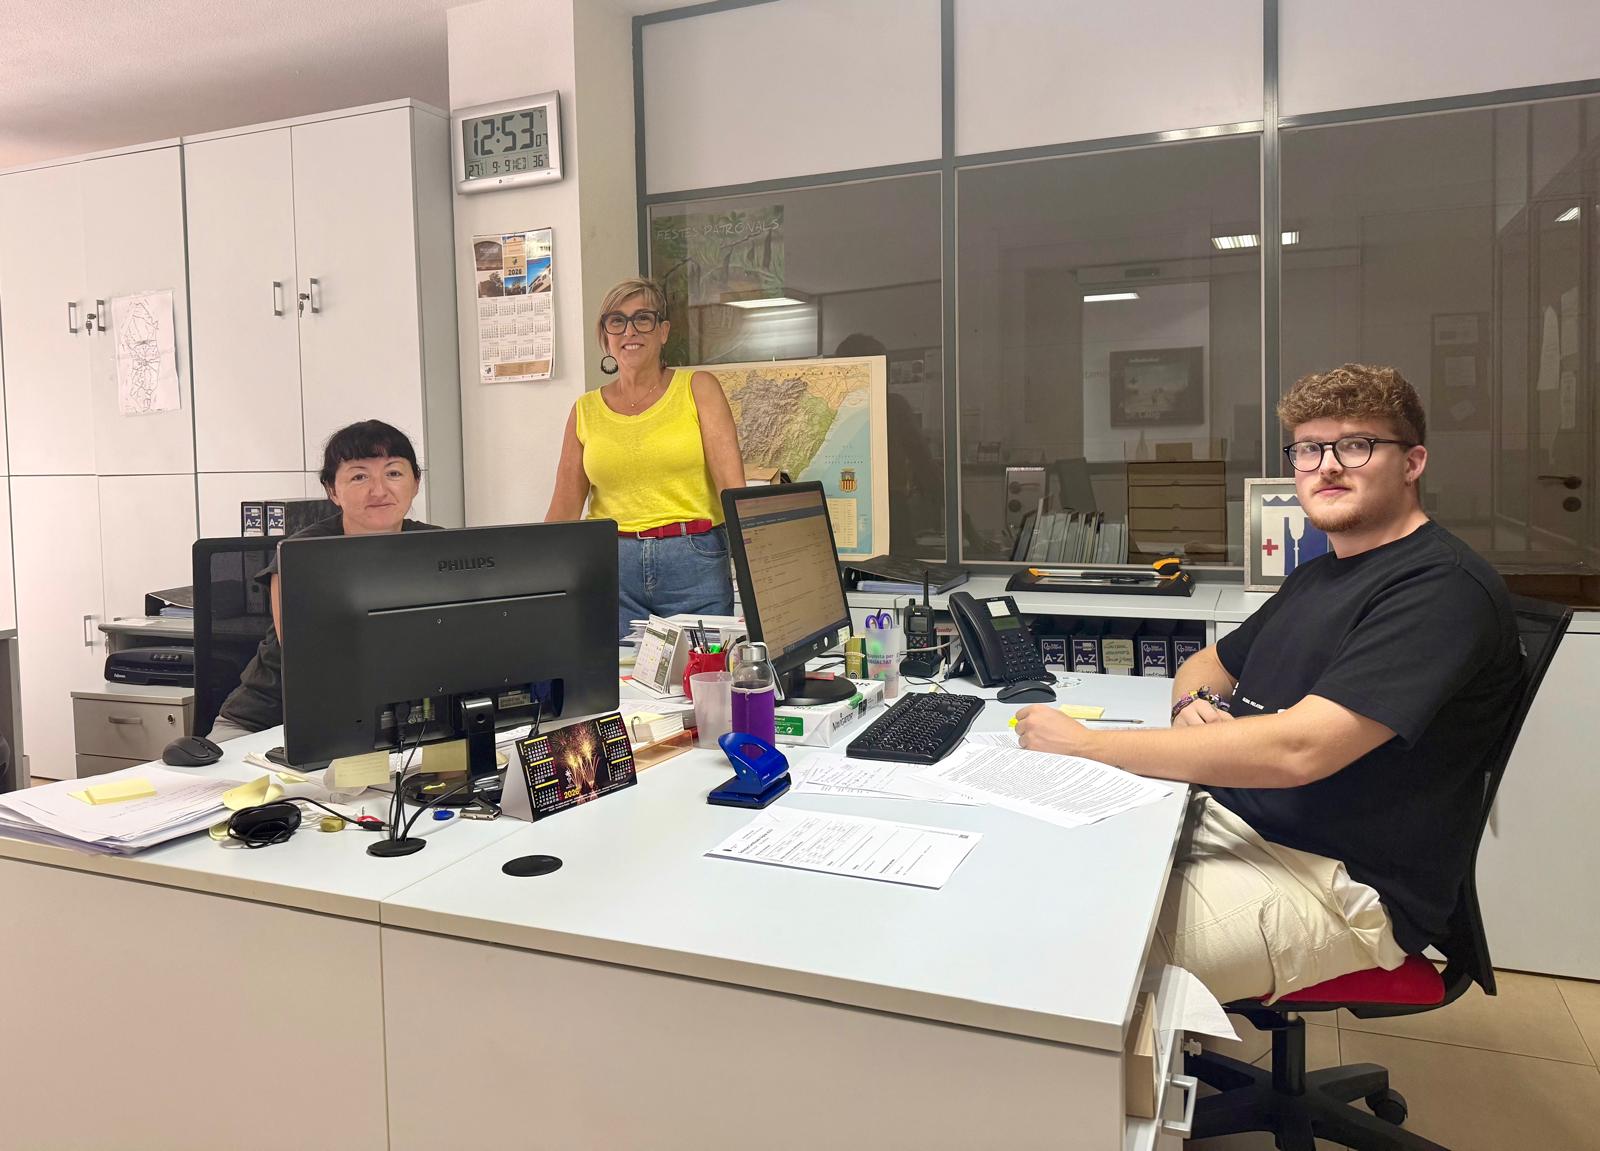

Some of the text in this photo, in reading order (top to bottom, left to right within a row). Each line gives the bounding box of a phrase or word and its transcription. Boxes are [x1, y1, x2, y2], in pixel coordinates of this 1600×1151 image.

[474, 112, 534, 155] 12:53
[704, 218, 779, 235] PATRONALS
[246, 518, 261, 527] A-Z
[269, 518, 284, 527] A-Z
[437, 556, 496, 572] PHILIPS
[1044, 653, 1065, 663] A-Z
[1075, 653, 1096, 663] A-Z
[1144, 655, 1166, 665] A-Z
[564, 788, 580, 799] 2026
